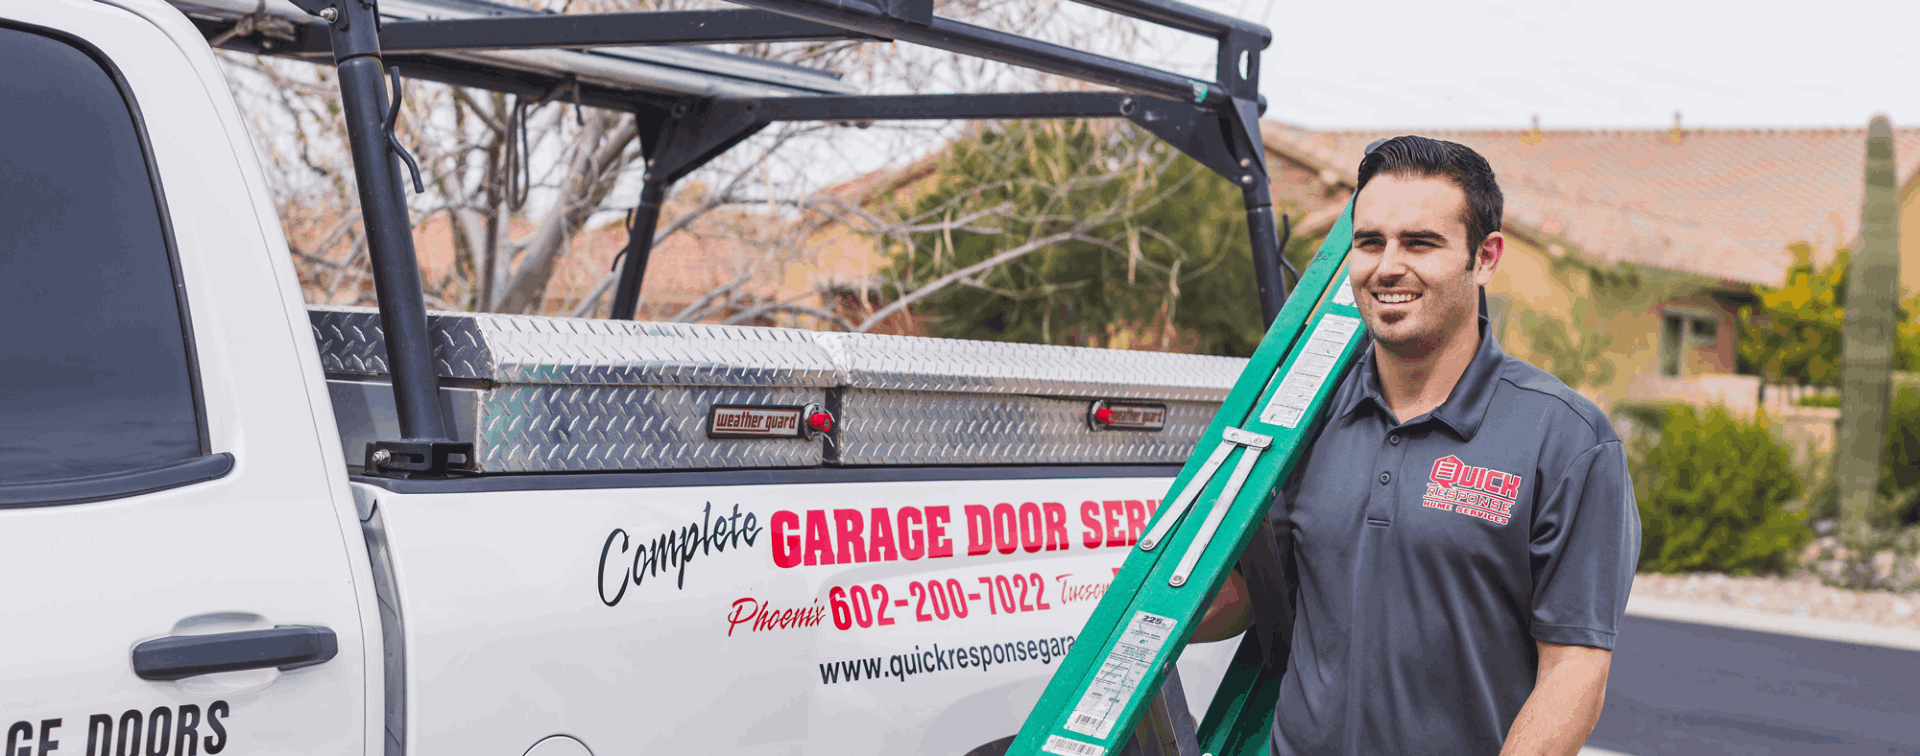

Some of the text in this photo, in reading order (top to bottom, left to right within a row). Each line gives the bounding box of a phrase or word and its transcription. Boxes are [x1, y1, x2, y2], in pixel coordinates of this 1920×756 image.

[716, 411, 798, 432] weather guard
[1429, 455, 1521, 499] QUICK
[1423, 499, 1508, 526] HOME SERVICES
[1427, 487, 1512, 513] RESPONSE
[598, 499, 1163, 607] Complete GARAGE DOOR SER
[727, 597, 826, 637] Phoenix
[829, 572, 1051, 631] 602-200-7022
[1142, 614, 1163, 625] 225
[86, 700, 230, 756] DOORS
